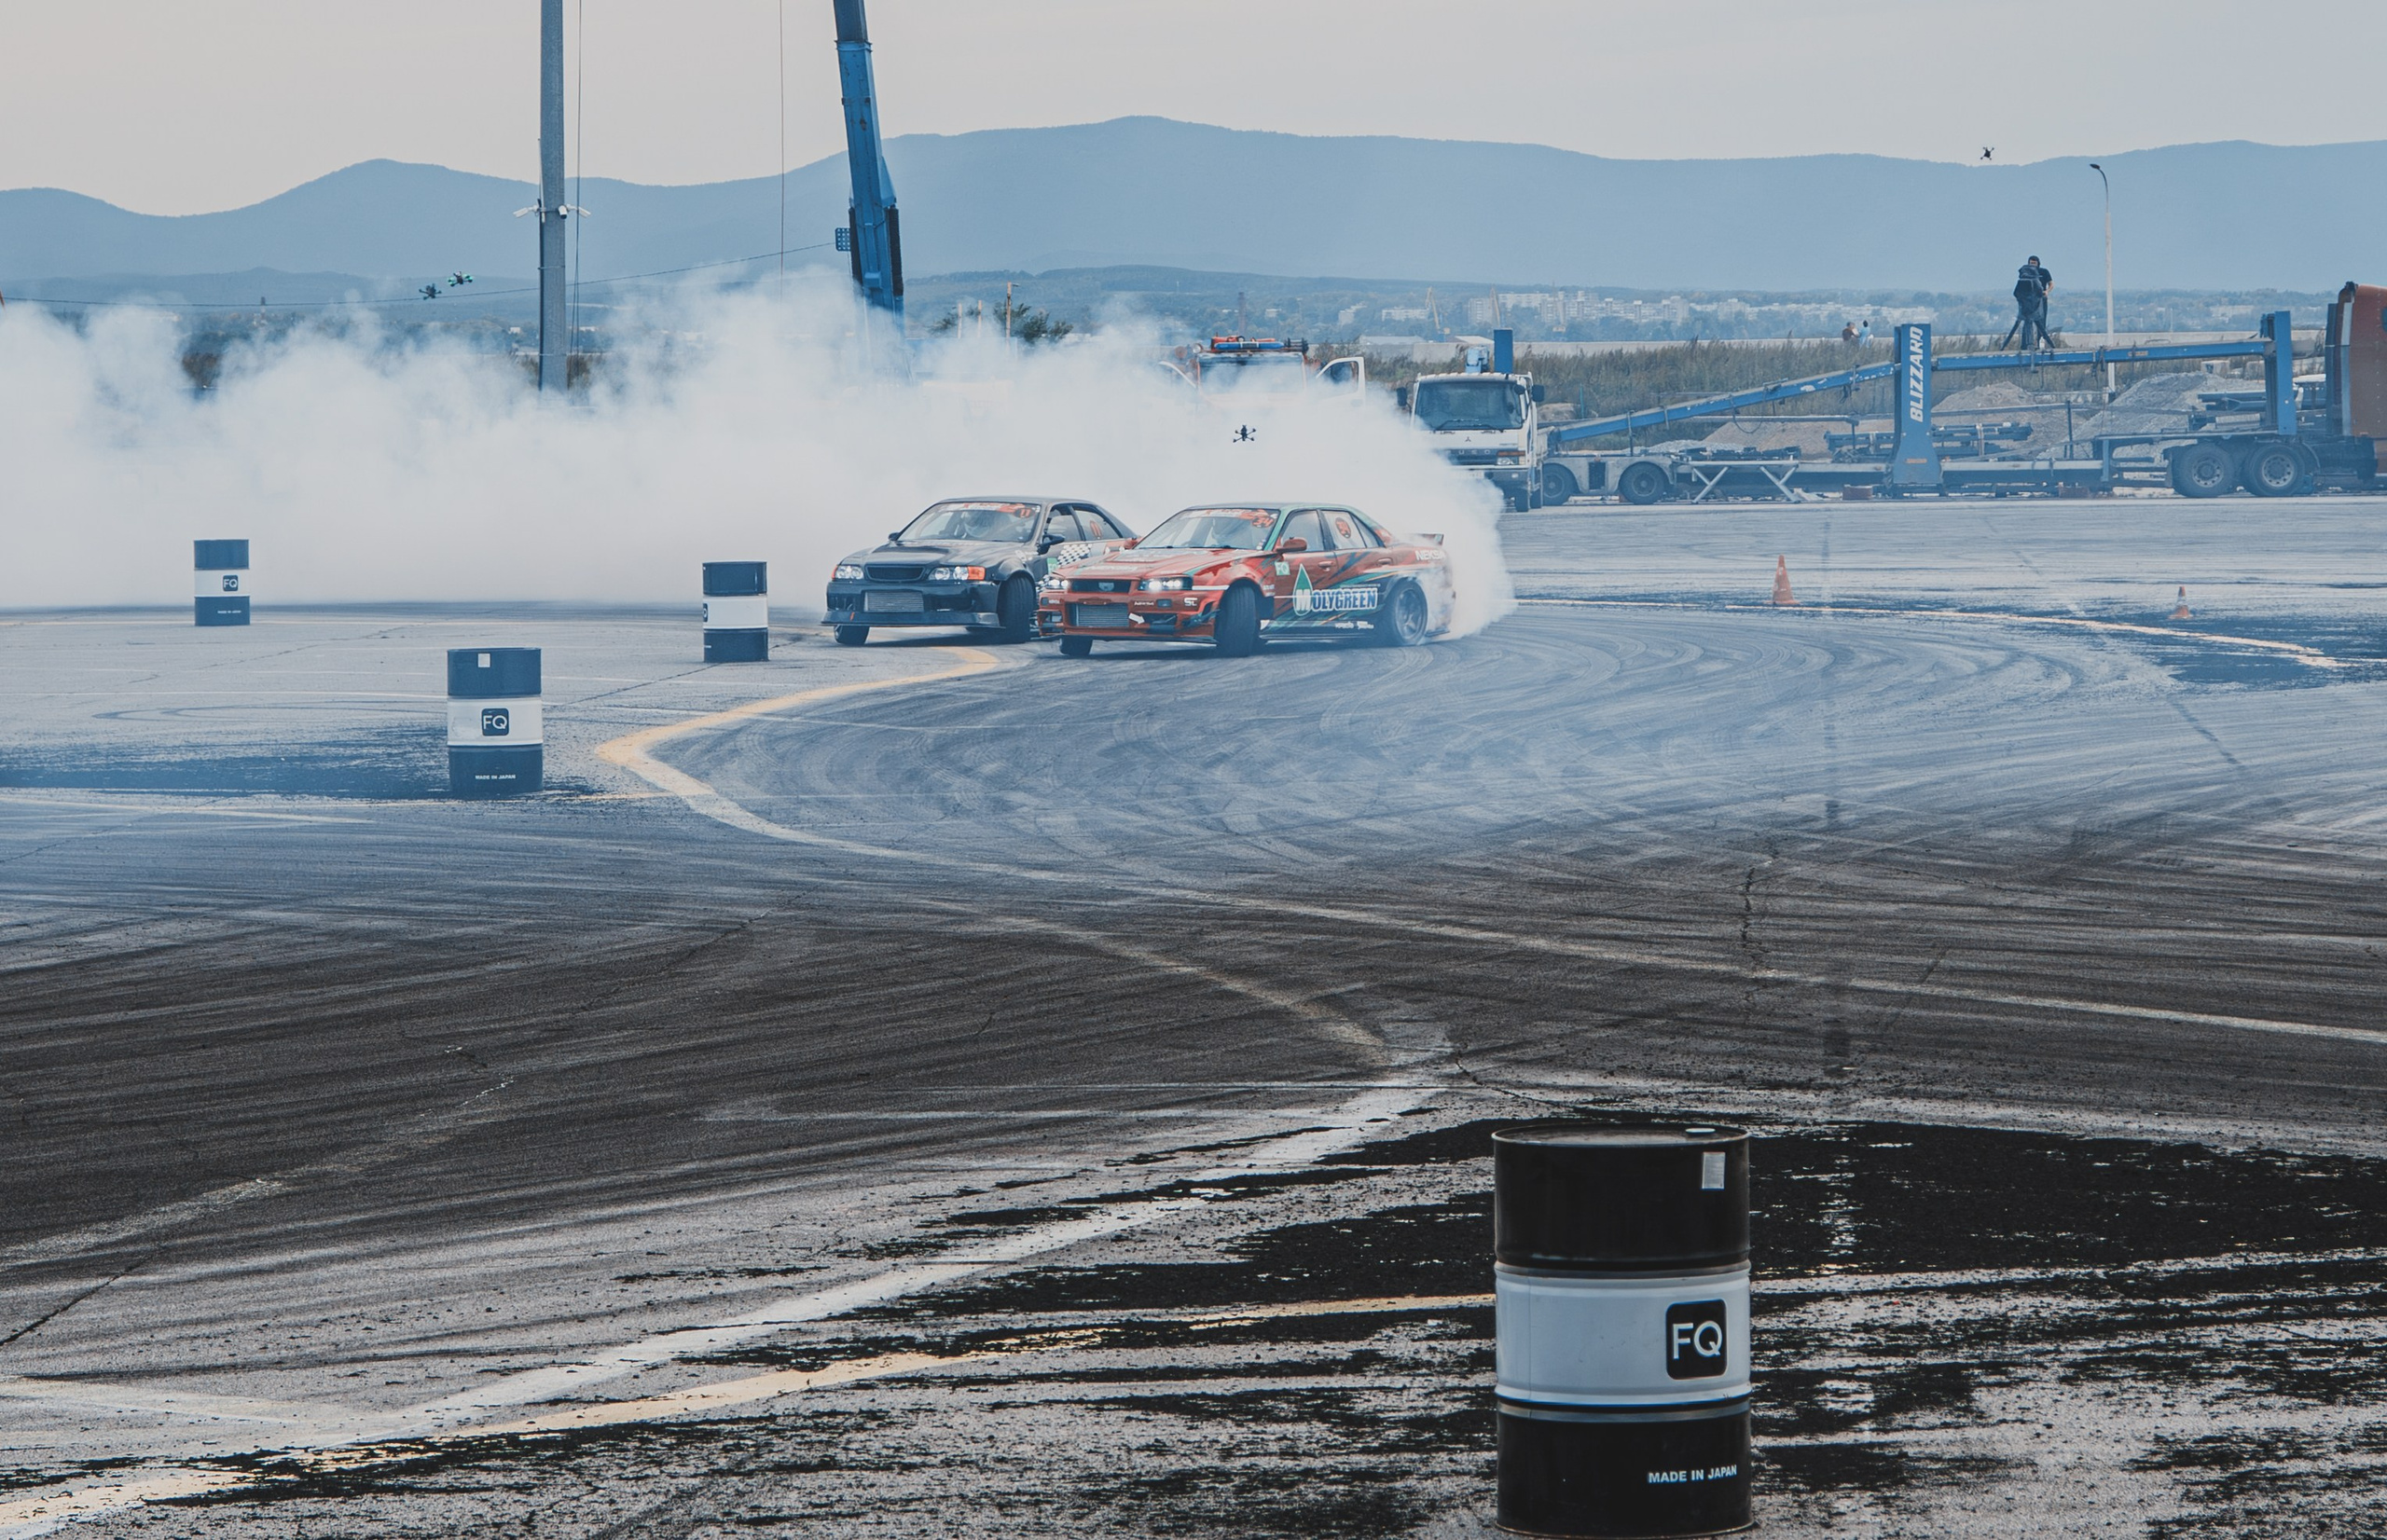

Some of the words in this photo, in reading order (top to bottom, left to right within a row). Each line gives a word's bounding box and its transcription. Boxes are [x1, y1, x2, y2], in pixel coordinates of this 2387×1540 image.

[1910, 326, 1923, 422] BLIZZARD
[1276, 561, 1290, 574] FQ
[224, 578, 238, 588] FQ
[1295, 587, 1377, 611] MOLYGREEN
[483, 715, 507, 729] FQ
[1673, 1320, 1722, 1359] FQ
[1649, 1471, 1687, 1483] MADE
[1691, 1469, 1704, 1480] IN
[1708, 1464, 1737, 1479] JAPAN
